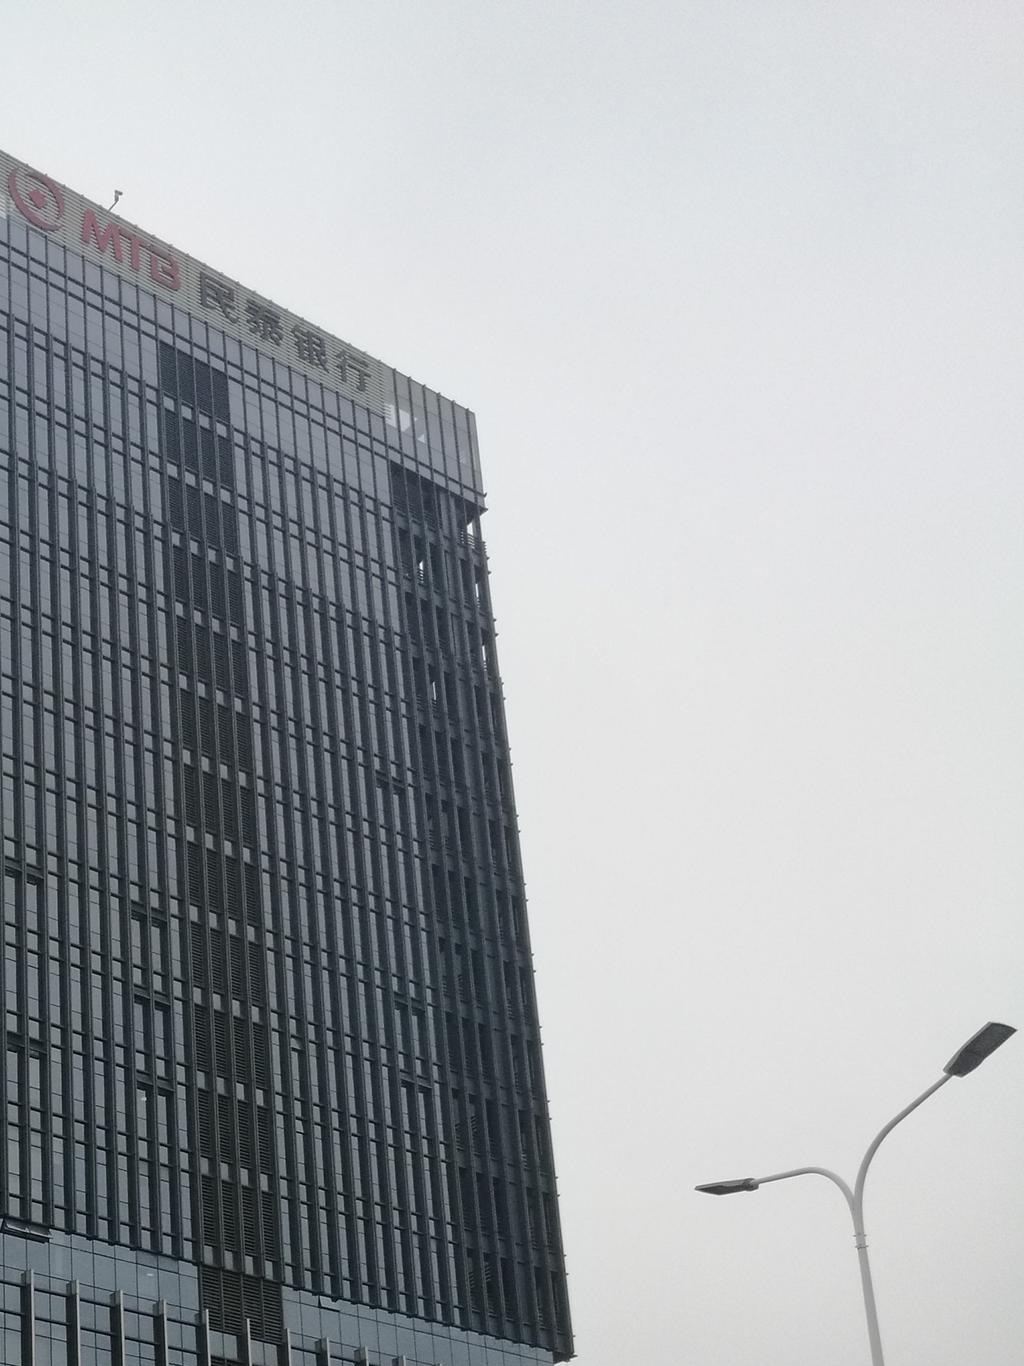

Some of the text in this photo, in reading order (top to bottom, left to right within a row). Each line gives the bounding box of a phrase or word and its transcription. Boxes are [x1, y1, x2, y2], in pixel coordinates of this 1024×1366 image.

[81, 208, 372, 392] MTB 民泰银行
